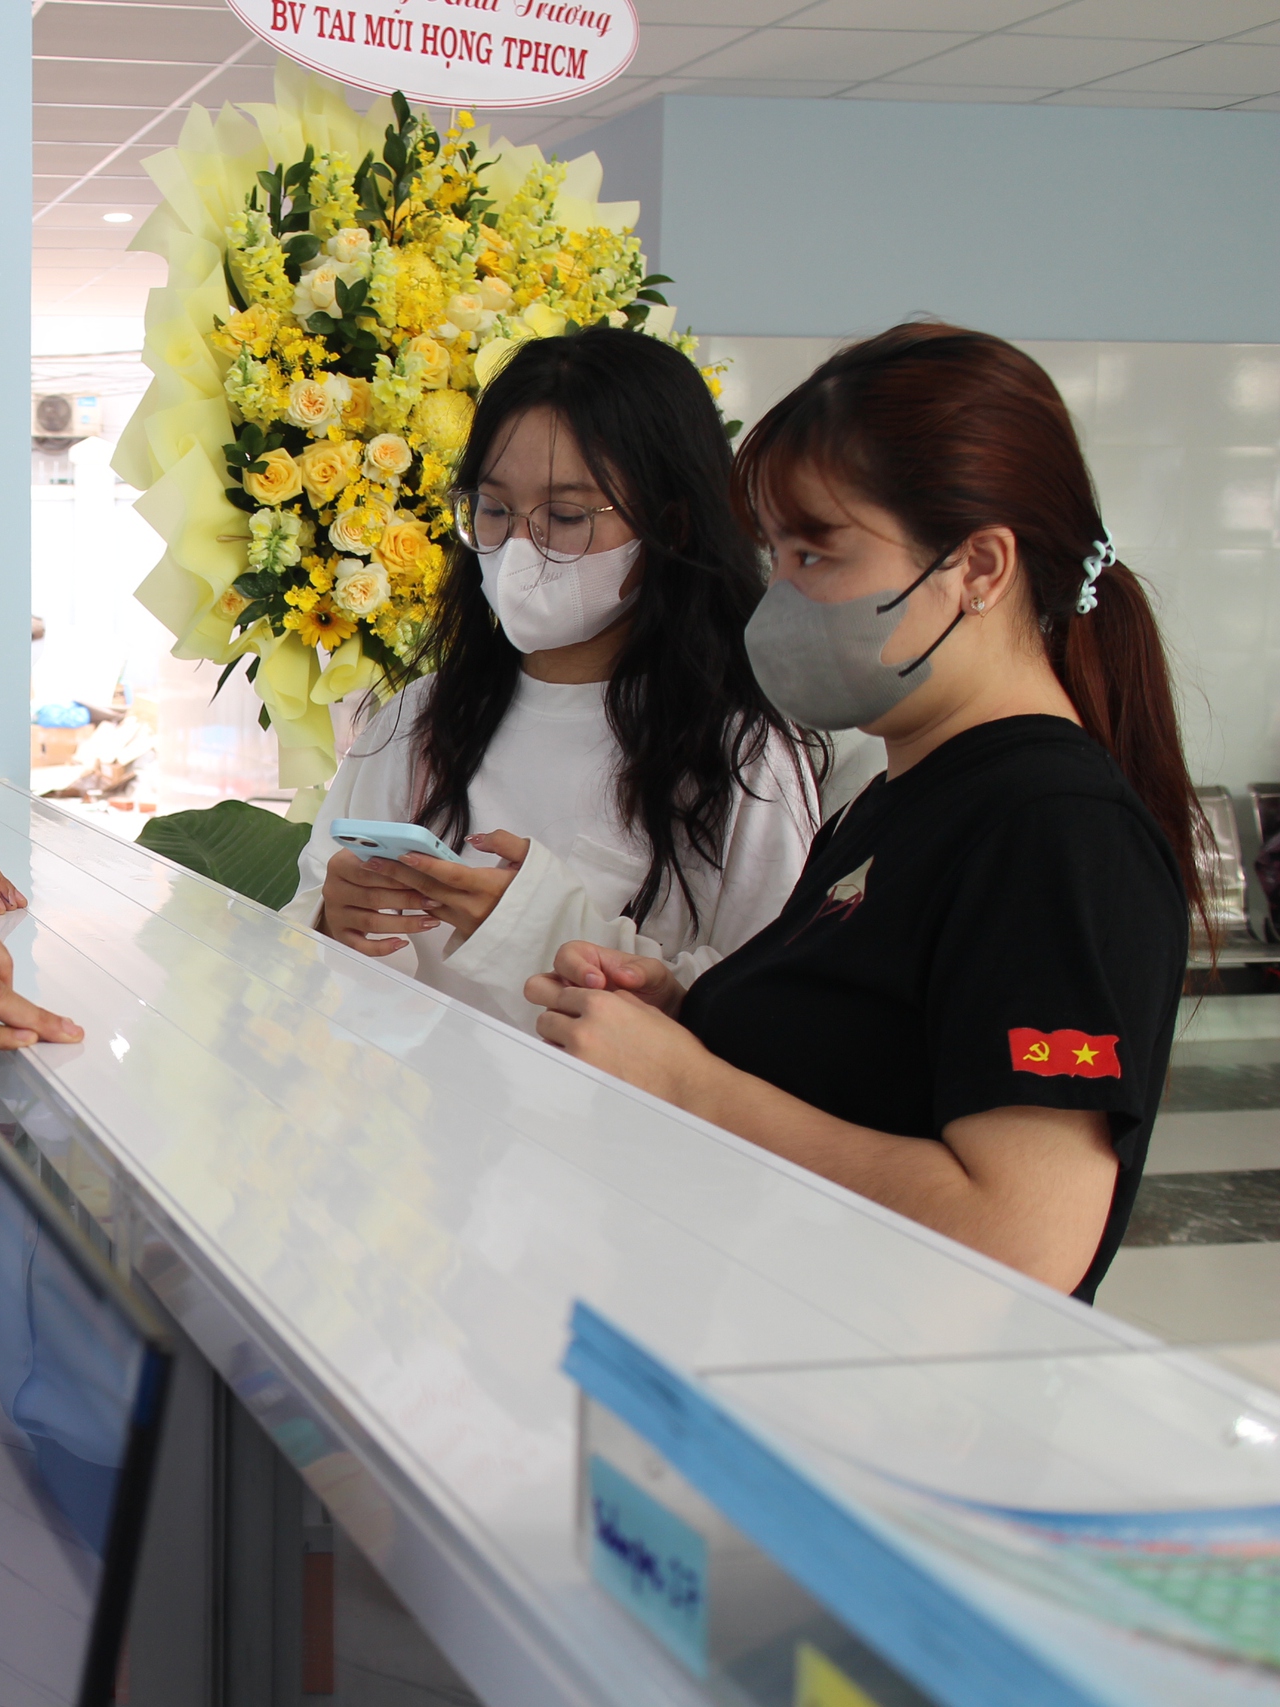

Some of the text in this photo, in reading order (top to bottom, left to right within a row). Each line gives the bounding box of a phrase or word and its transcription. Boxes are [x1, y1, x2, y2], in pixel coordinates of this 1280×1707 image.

[271, 0, 588, 80] BV TAI MŨI HỌNG TPHCM
